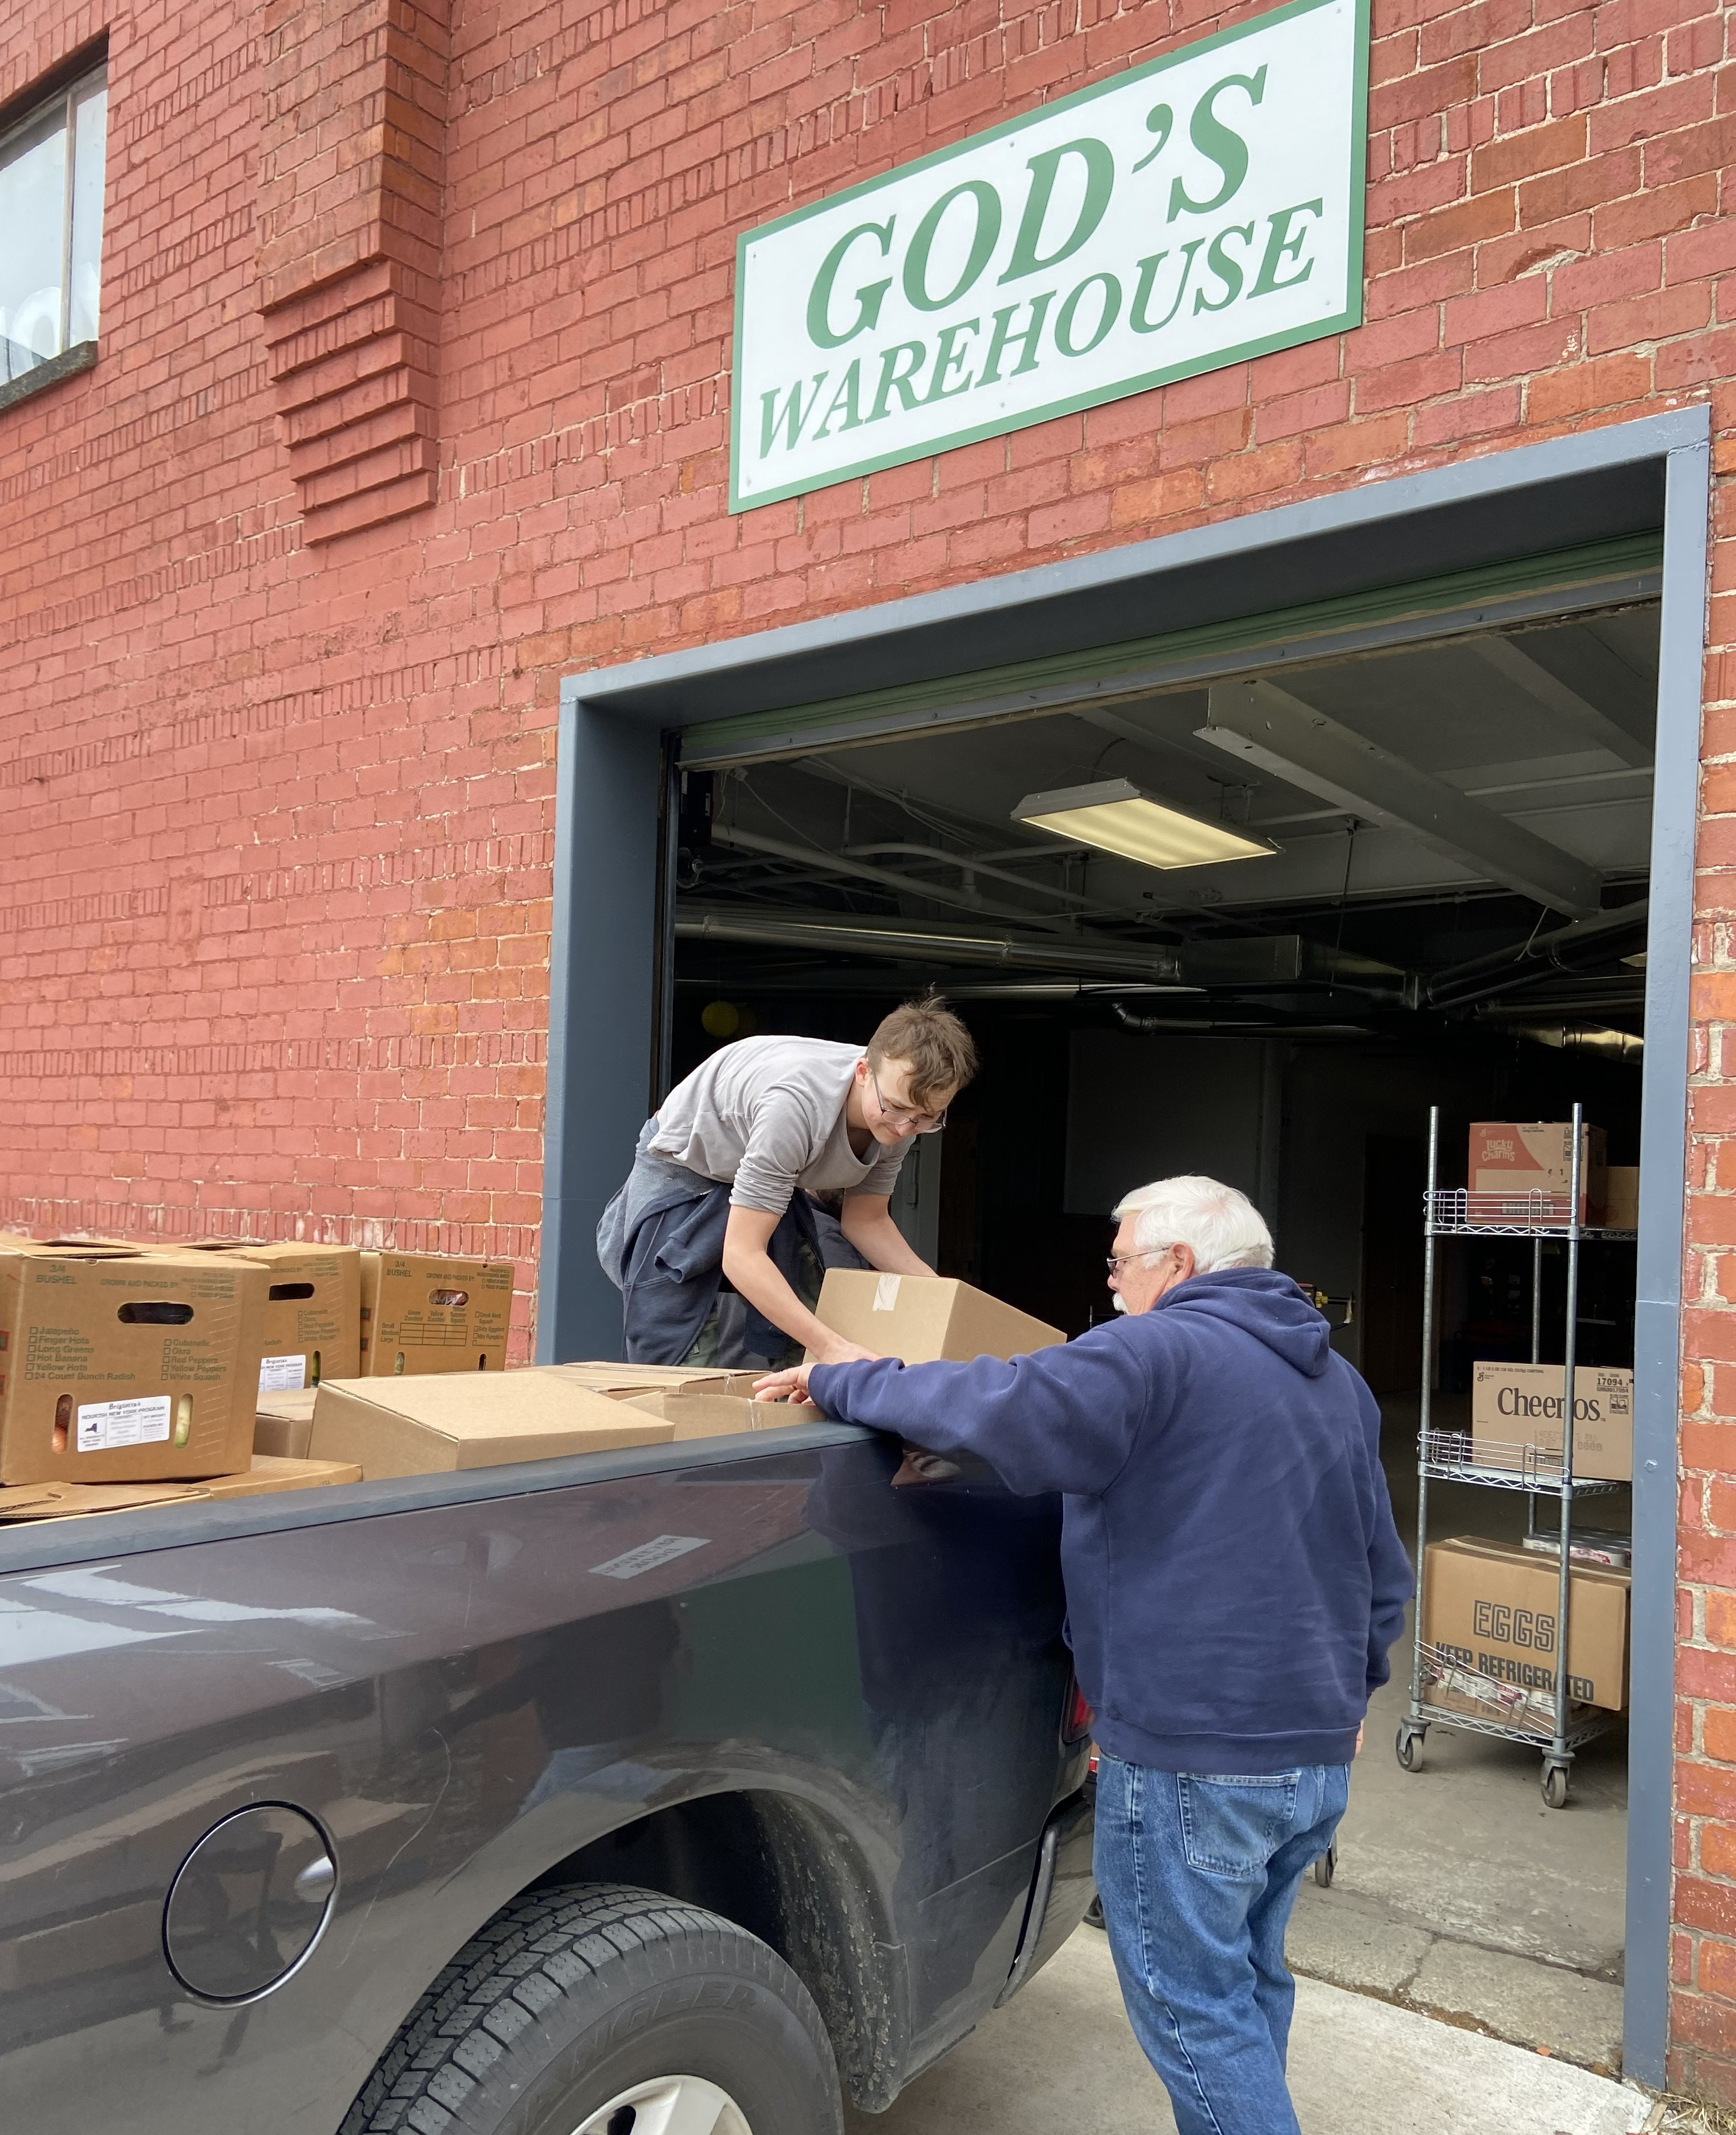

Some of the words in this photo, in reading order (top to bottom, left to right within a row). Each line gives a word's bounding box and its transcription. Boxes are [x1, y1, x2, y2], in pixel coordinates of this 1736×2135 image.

[806, 63, 1268, 349] GOD'S
[758, 197, 1323, 459] WAREHOUSE
[1486, 1139, 1513, 1151] Lucky
[1481, 1150, 1516, 1162] Charms
[386, 1268, 412, 1278] BUSHEL
[36, 1274, 78, 1285] BUSHEL
[39, 1327, 80, 1336] Jalapeño
[38, 1336, 67, 1345] Finger
[37, 1345, 61, 1355] Long
[63, 1345, 94, 1353] Greens
[55, 1354, 87, 1362] Banana
[188, 1356, 219, 1365] Peppers
[196, 1364, 227, 1373] Peppers
[48, 1372, 75, 1380] Count
[77, 1372, 106, 1380] Bunch
[107, 1372, 135, 1380] Radish
[193, 1373, 221, 1381] Squash
[1597, 1378, 1622, 1386] 17094
[1497, 1387, 1601, 1421] Cheeros
[1473, 1599, 1555, 1653] EGGS
[1436, 1641, 1473, 1669] KEEP
